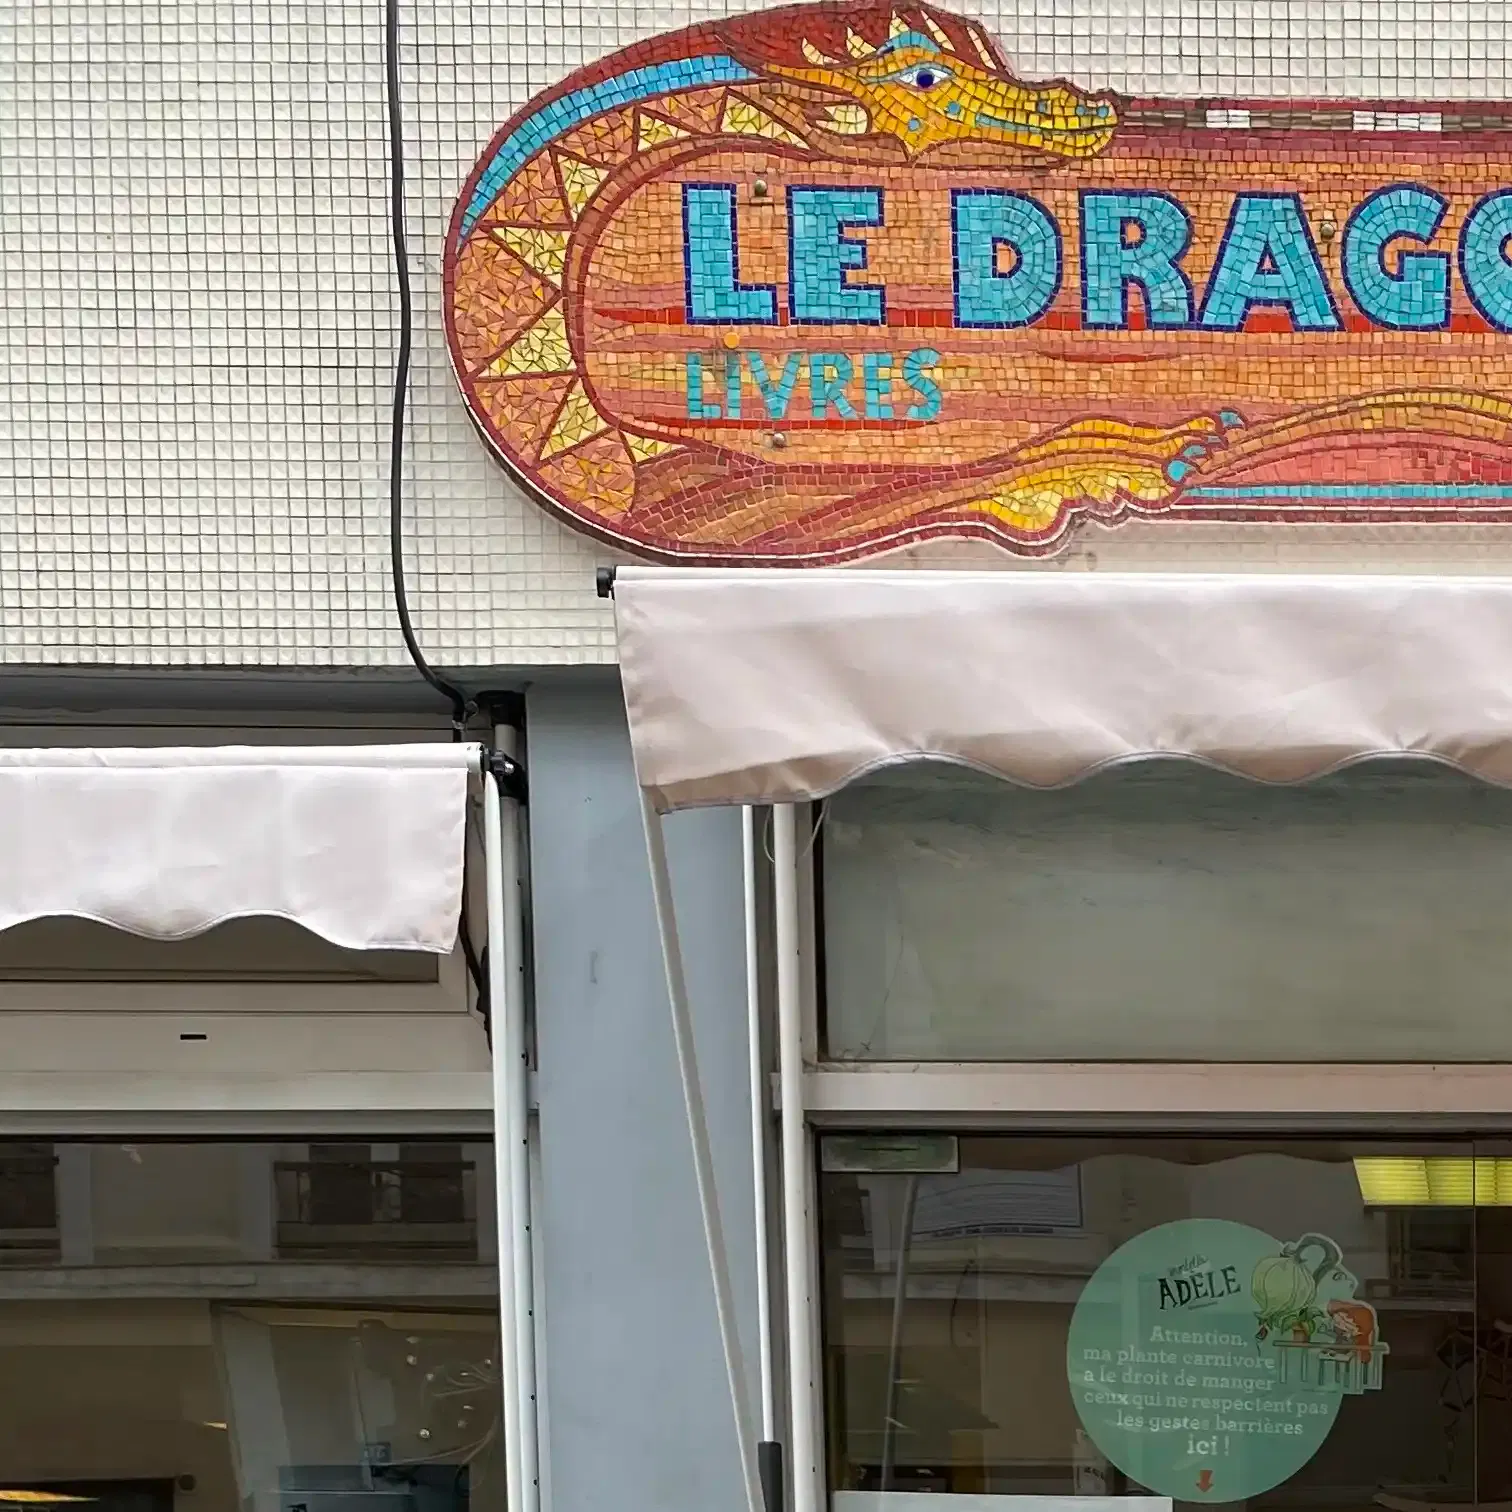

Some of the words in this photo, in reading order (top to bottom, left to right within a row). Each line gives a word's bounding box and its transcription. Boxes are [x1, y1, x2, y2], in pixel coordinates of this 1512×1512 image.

[682, 183, 884, 326] LE
[686, 346, 944, 422] LIVRES
[1150, 1325, 1248, 1347] Attention,
[1083, 1348, 1111, 1361] ma
[1117, 1346, 1177, 1366] plante
[1183, 1352, 1275, 1369] carnivore
[1083, 1370, 1094, 1381] a
[1100, 1365, 1117, 1382] le
[1122, 1368, 1168, 1386] droit
[1174, 1369, 1196, 1387] de
[1201, 1376, 1274, 1394] manger
[1083, 1391, 1128, 1405] ceux
[1132, 1391, 1161, 1410] qui
[1165, 1394, 1188, 1408] ne
[1191, 1396, 1293, 1413] respectent
[1297, 1400, 1328, 1418] pas
[1117, 1409, 1144, 1428] les
[1149, 1414, 1210, 1433] gestes
[1216, 1413, 1303, 1435] barrières
[1186, 1434, 1219, 1456] ici
